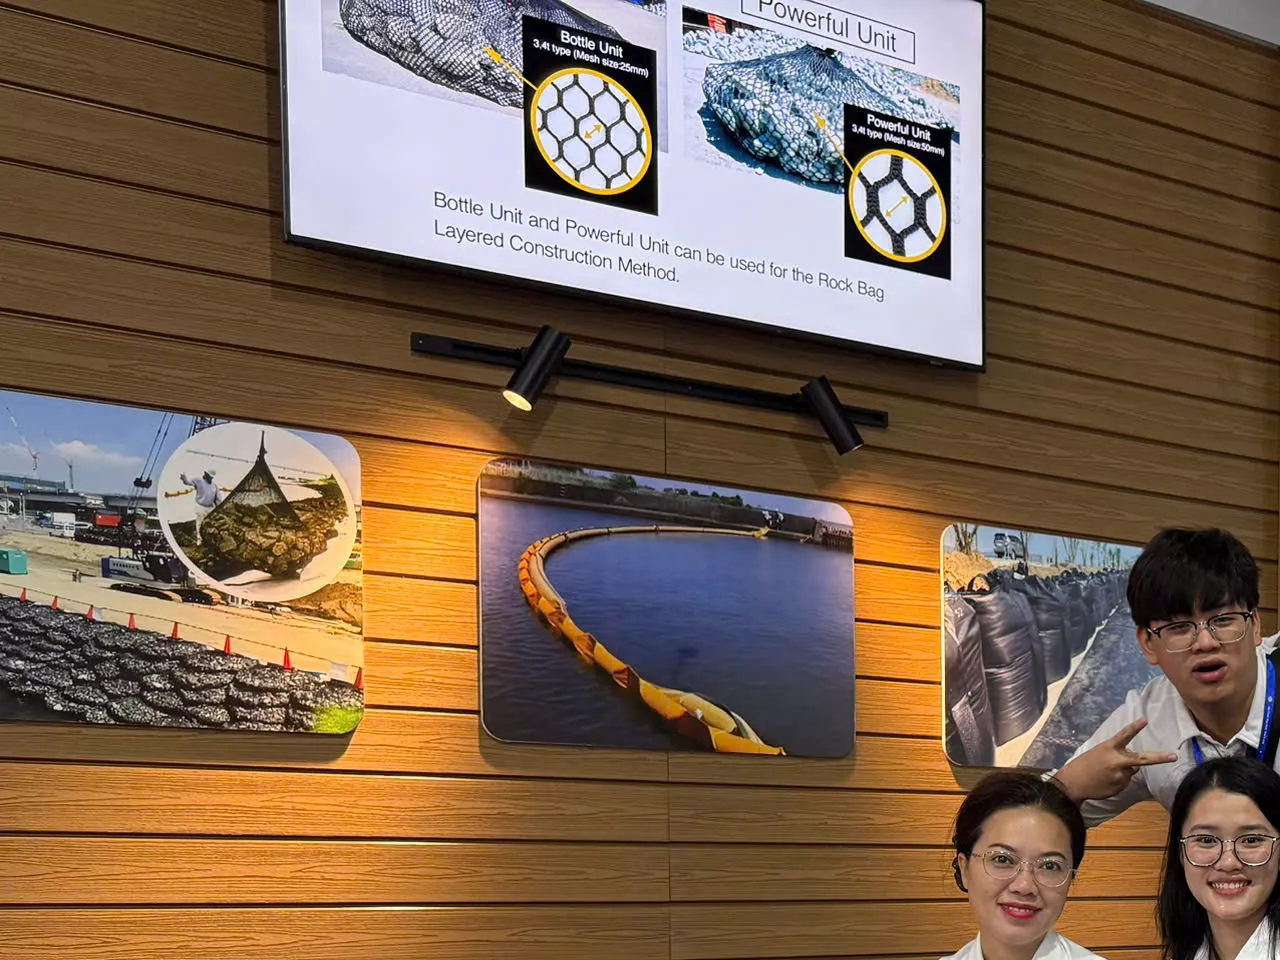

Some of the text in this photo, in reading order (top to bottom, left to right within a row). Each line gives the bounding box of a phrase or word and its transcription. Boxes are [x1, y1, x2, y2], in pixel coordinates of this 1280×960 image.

[759, 0, 897, 52] Powerful Unit
[551, 43, 571, 57] type
[573, 48, 600, 65] (Mesh
[560, 30, 624, 58] Bottle Unit
[866, 127, 882, 139] type
[883, 132, 906, 145] (Mesh
[867, 113, 931, 142] Powerful Unit
[433, 191, 885, 302] Bottle Unit and Powerful Unit can be used for the Rock Bag
[433, 219, 680, 284] Layered Construction Method.
